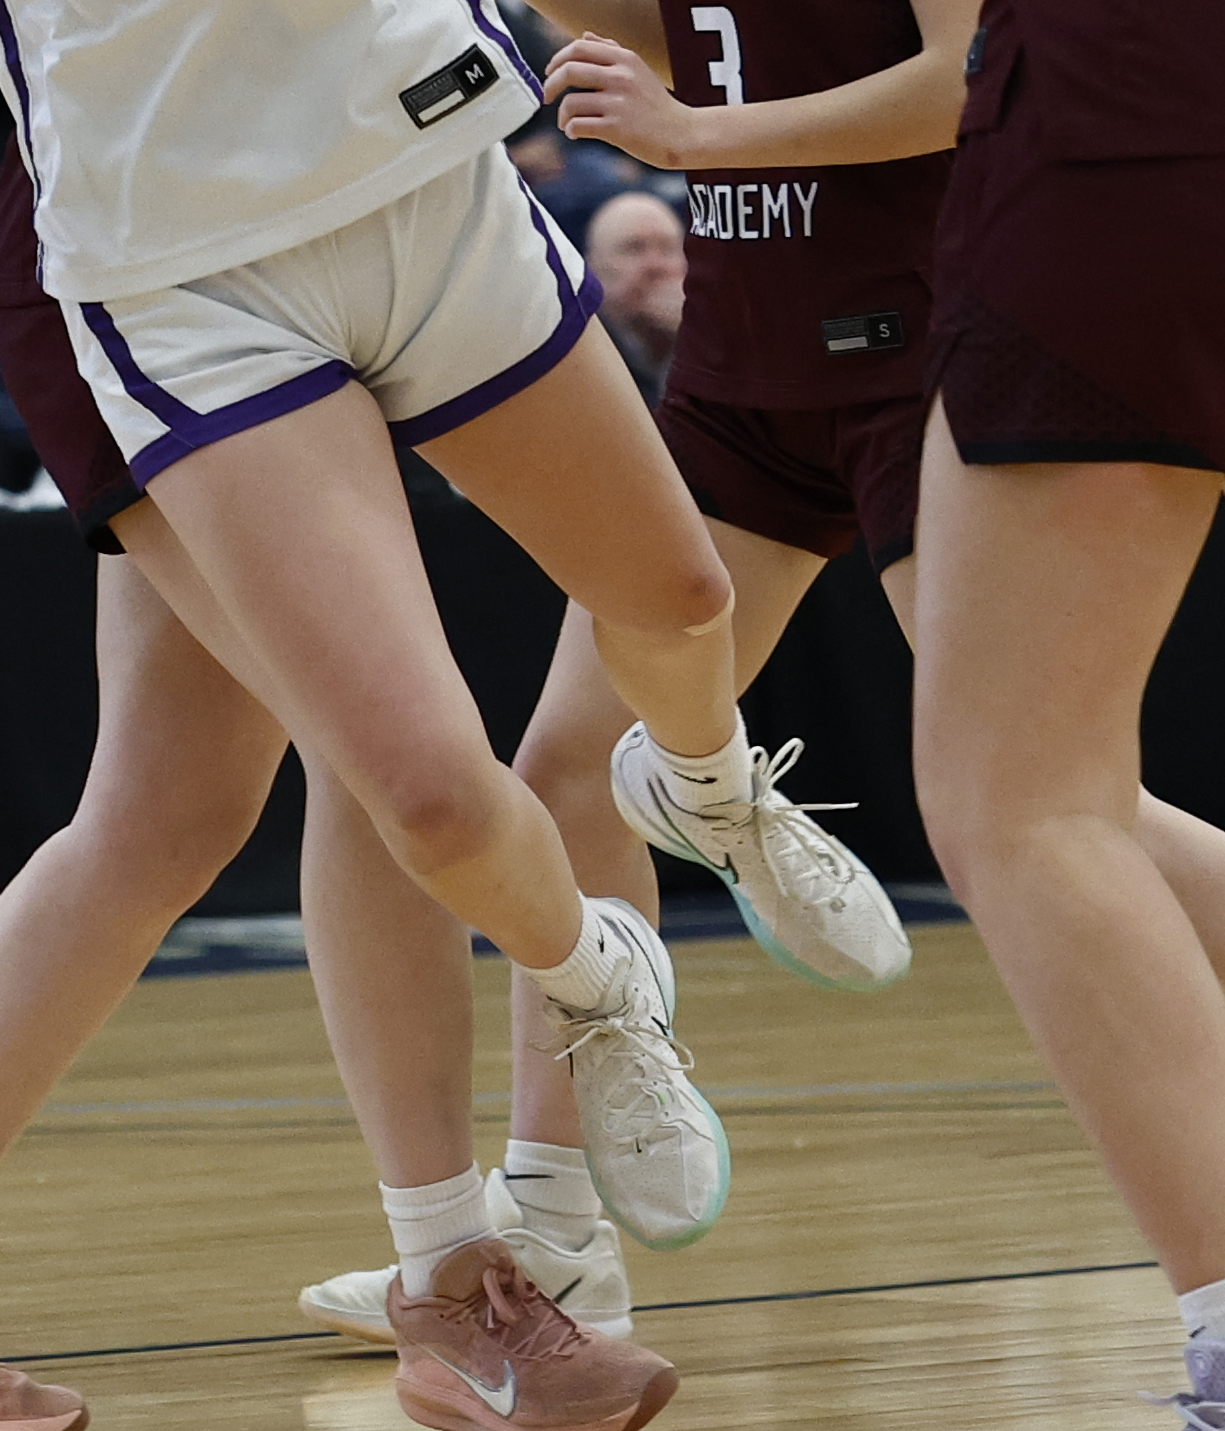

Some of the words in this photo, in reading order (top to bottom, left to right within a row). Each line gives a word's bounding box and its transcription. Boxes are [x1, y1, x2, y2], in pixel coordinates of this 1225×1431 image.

[689, 5, 745, 105] 3
[463, 62, 486, 86] M
[878, 322, 891, 339] S
